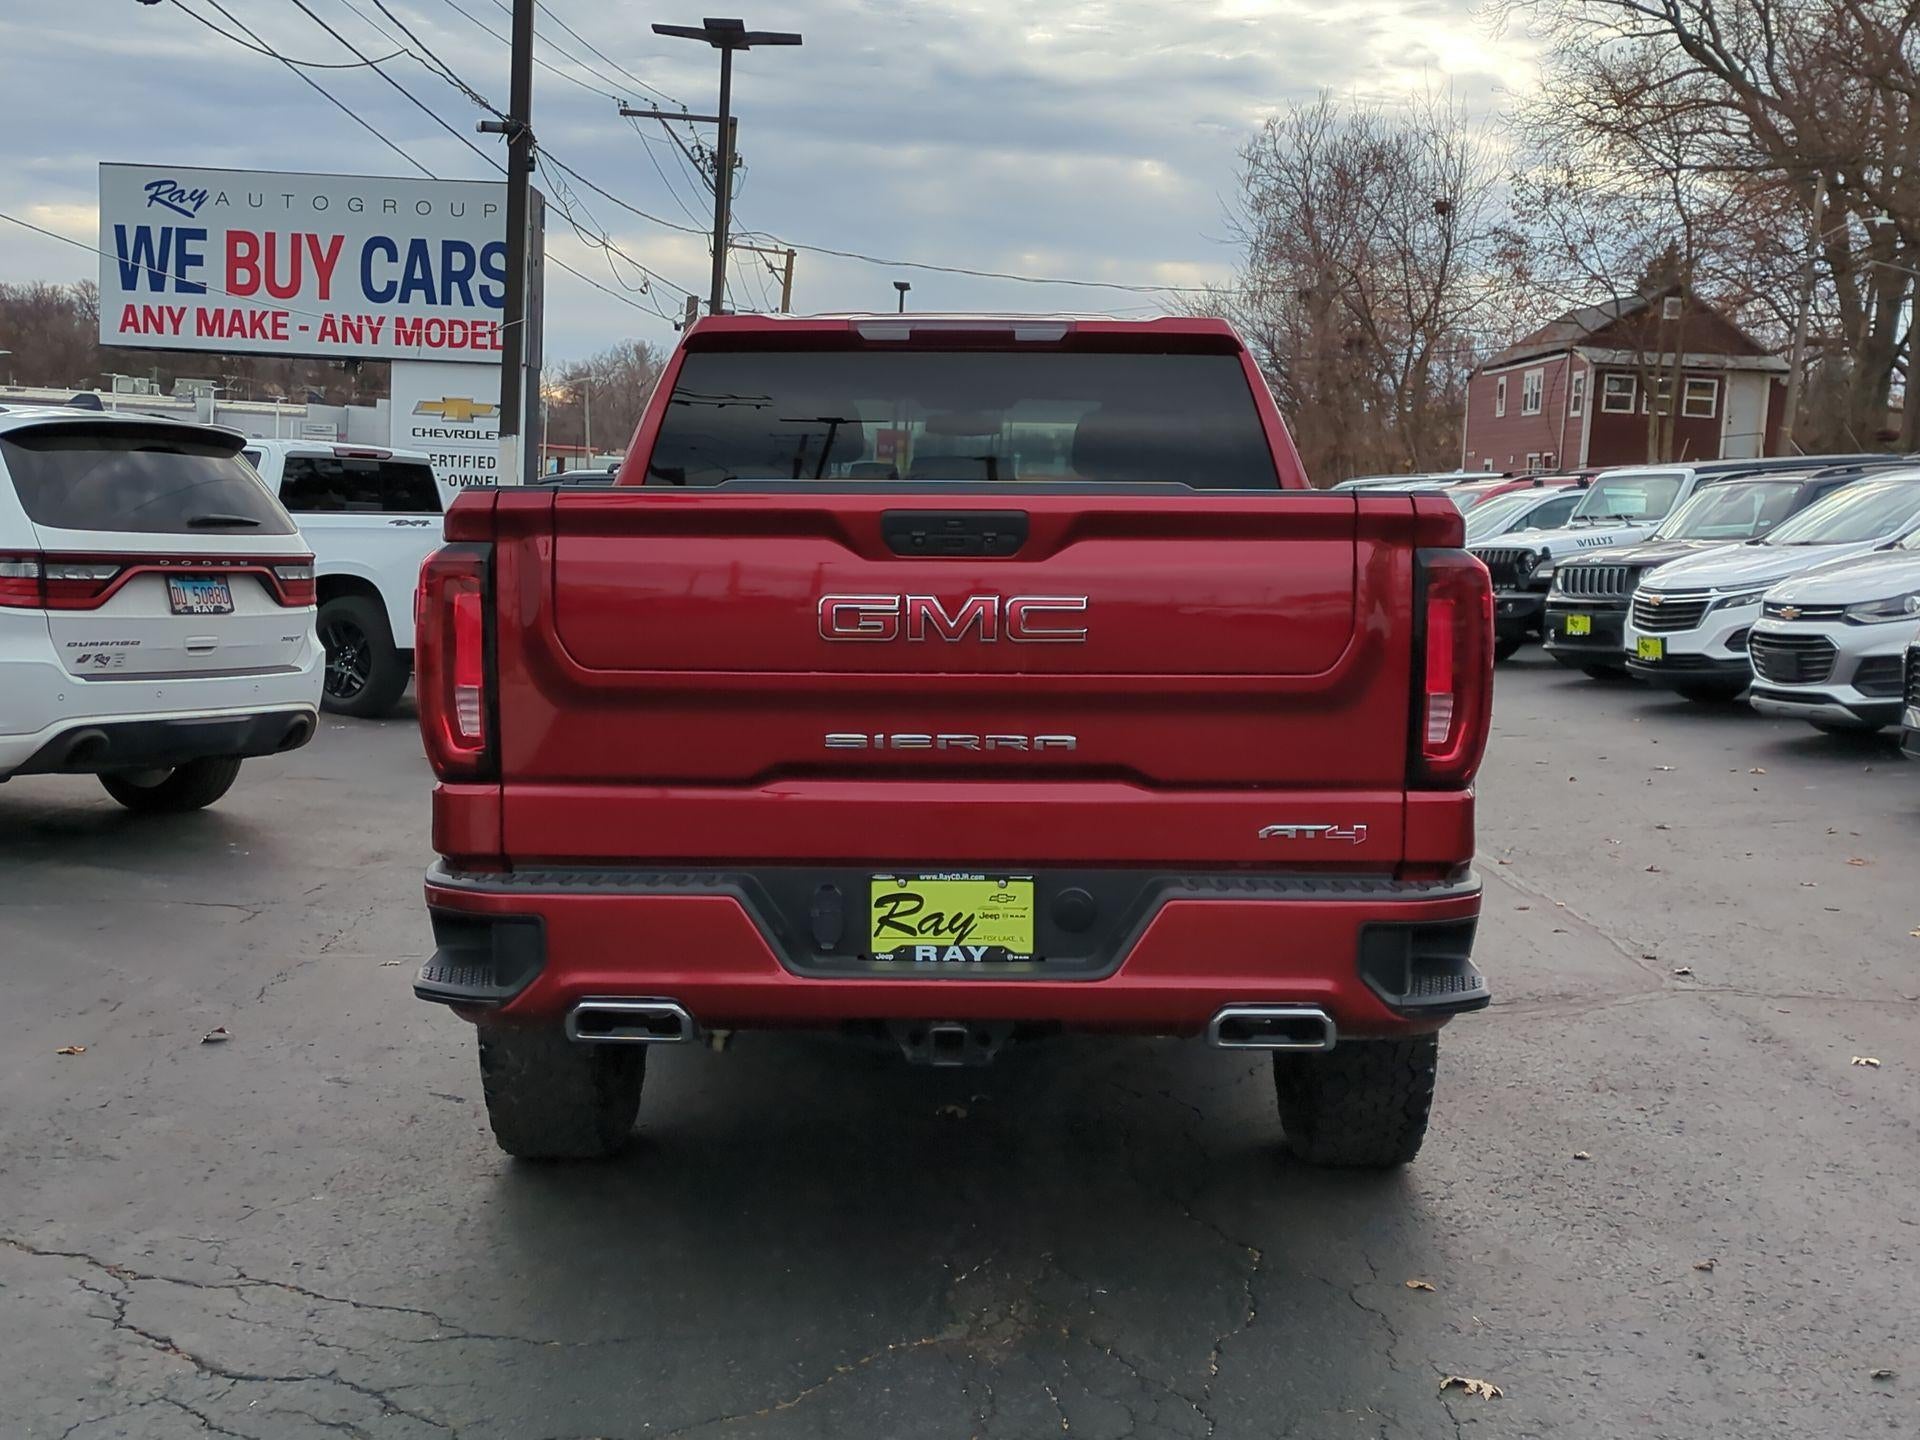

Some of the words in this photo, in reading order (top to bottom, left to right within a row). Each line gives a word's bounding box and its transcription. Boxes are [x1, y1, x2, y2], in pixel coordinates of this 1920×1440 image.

[144, 179, 210, 219] Ray
[113, 223, 208, 295] WE
[225, 229, 345, 301] BUY
[360, 235, 507, 309] CARS
[118, 303, 188, 336] ANY
[195, 306, 290, 341] MAKE
[317, 312, 386, 345] ANY
[394, 316, 504, 351] MODEL
[428, 452, 497, 470] ERTIFIED
[1575, 535, 1614, 548] WILLYS
[159, 559, 248, 567] DODGE
[193, 604, 216, 614] RAY
[817, 593, 1088, 642] GMC
[824, 732, 1077, 751] SIERRA
[1258, 824, 1367, 845] AT4
[919, 872, 985, 882] www.RayCDJR.com
[873, 892, 978, 946] Ray
[978, 911, 1000, 921] Jeep
[914, 945, 990, 962] RAY
